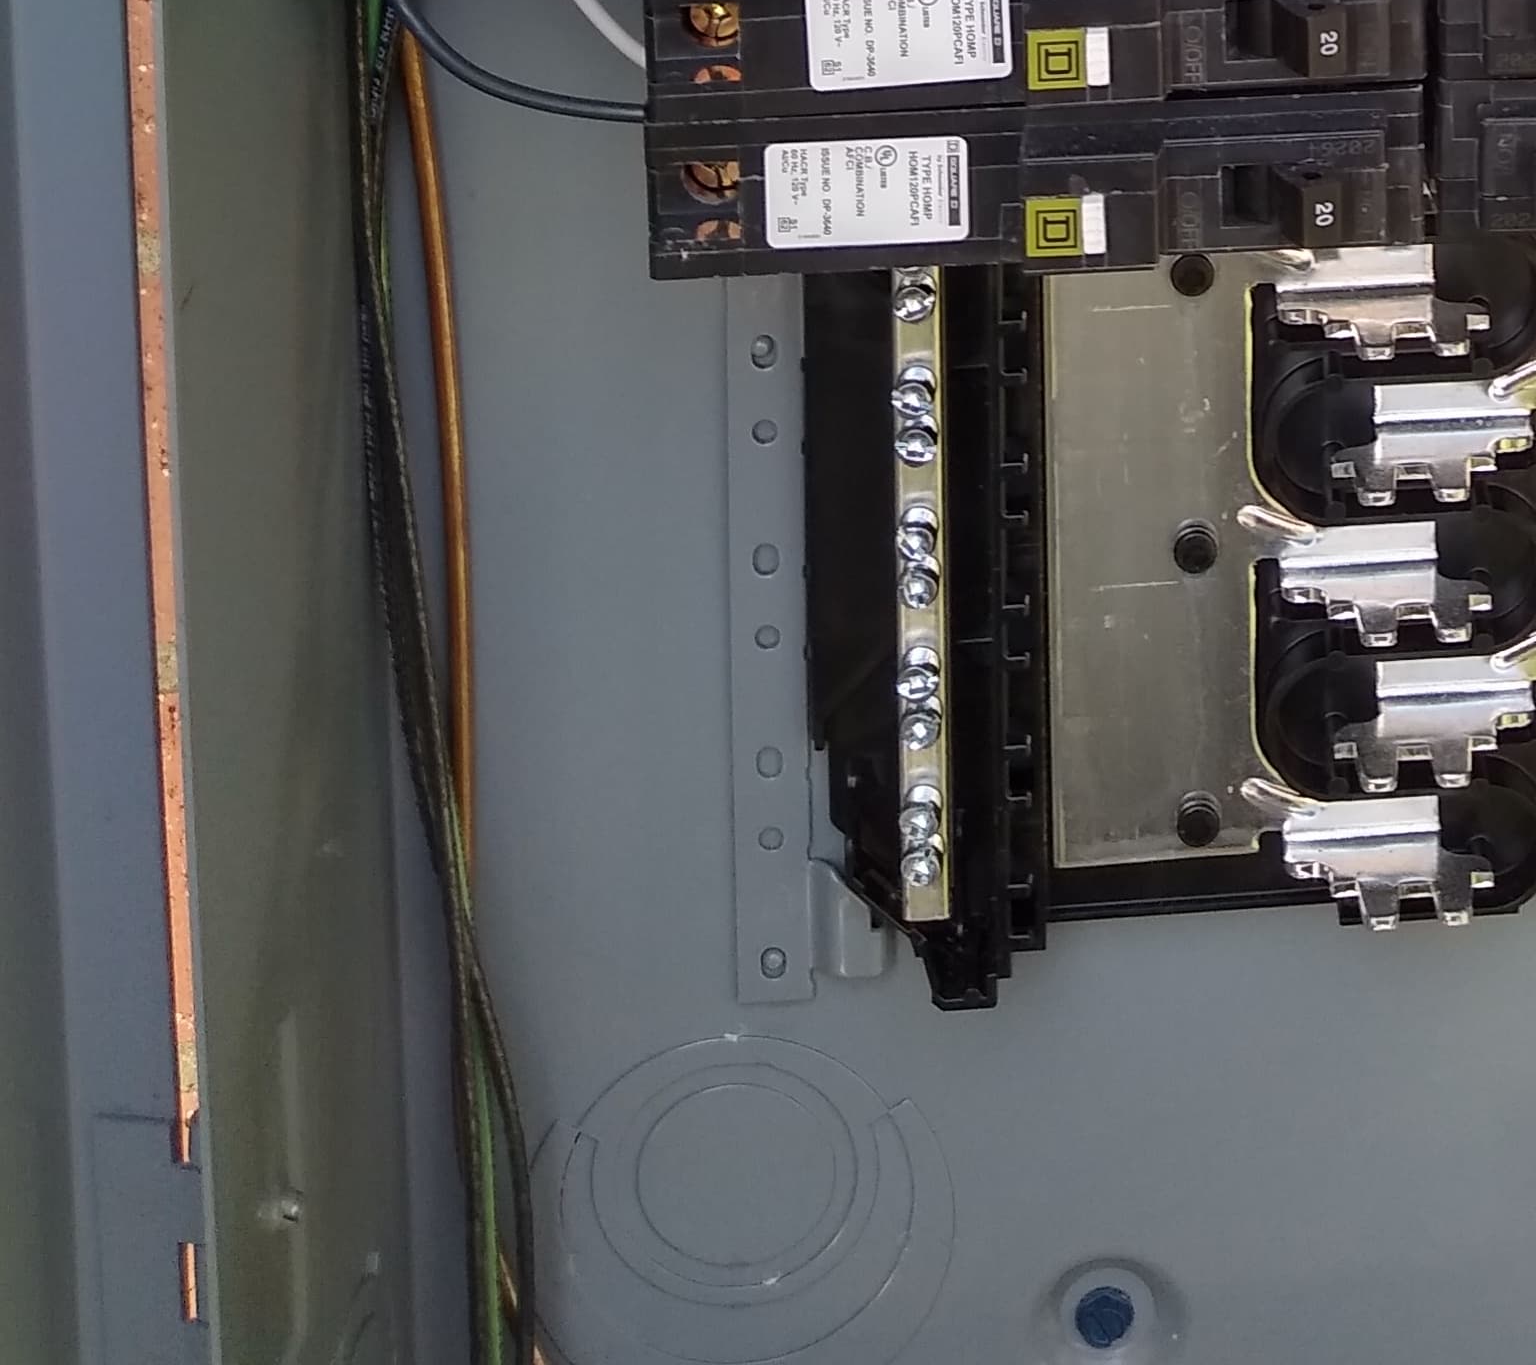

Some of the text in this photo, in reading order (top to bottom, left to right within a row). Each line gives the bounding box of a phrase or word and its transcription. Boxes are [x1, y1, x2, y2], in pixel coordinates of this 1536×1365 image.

[864, 40, 876, 77] DP-3640
[966, 24, 977, 58] HOMP
[1320, 31, 1338, 56] 20
[821, 148, 831, 176] ISSUE
[845, 147, 854, 170] AFCI
[855, 147, 865, 217] COMBINATION
[908, 151, 920, 226] HOM120PCAFI
[922, 155, 933, 220] TYPE HOMP
[822, 199, 832, 236] DP-3640
[1315, 202, 1334, 227] 20
